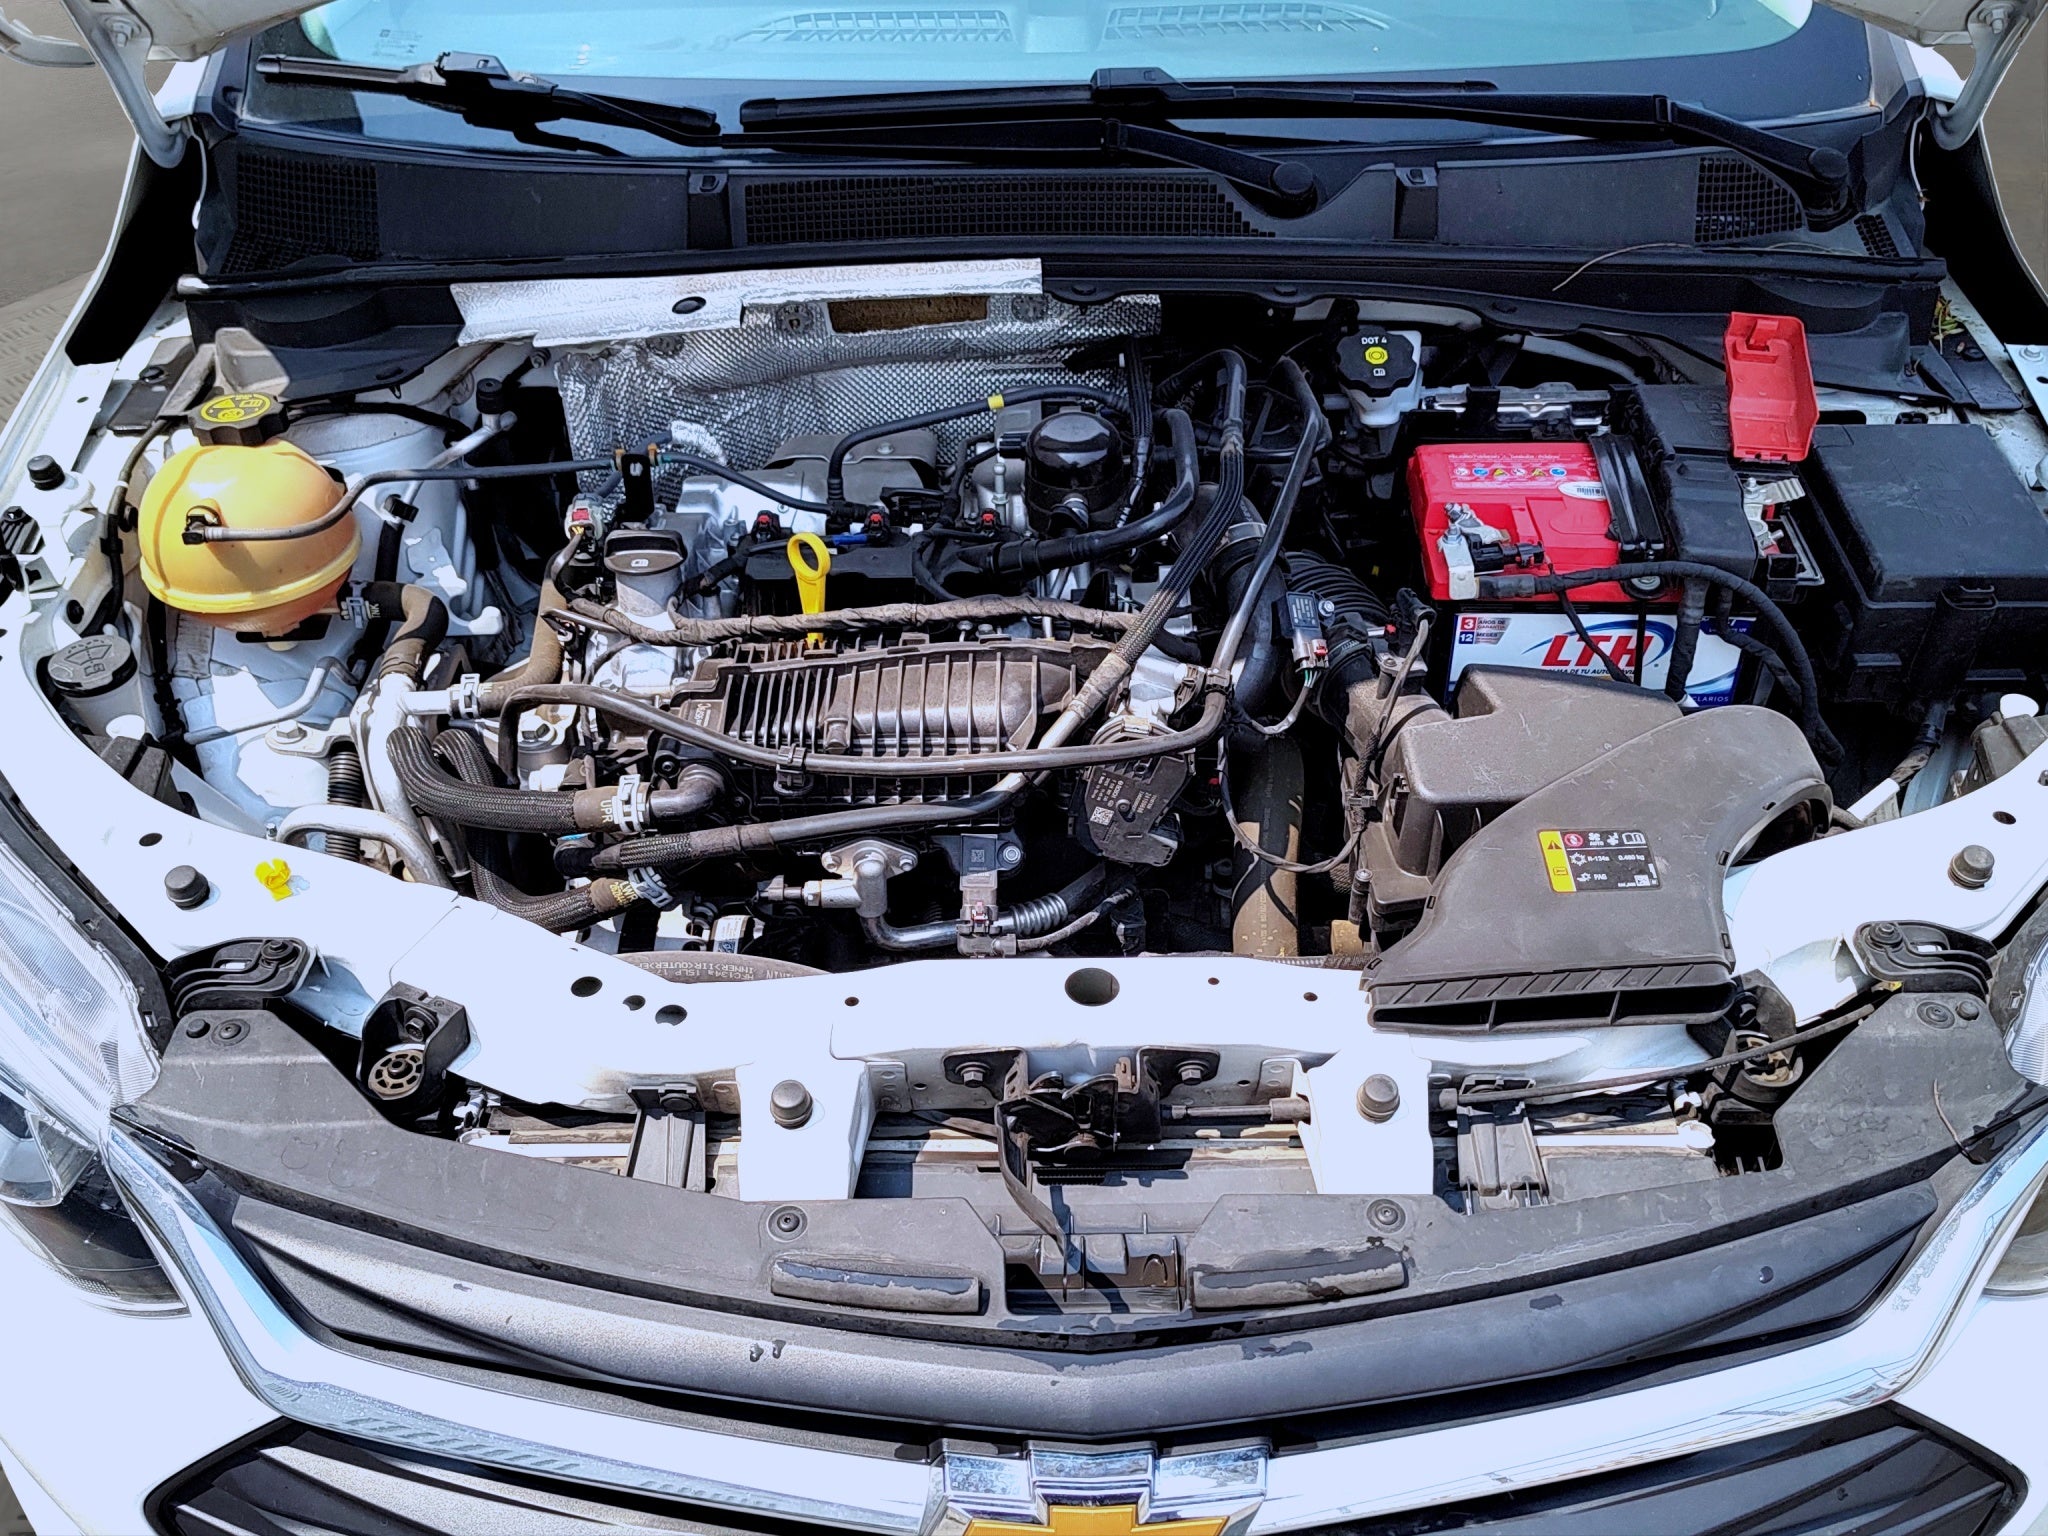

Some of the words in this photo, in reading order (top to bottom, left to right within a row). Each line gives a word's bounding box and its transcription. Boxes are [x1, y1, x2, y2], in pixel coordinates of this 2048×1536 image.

[1361, 336, 1379, 345] DOT
[1381, 336, 1387, 344] 4
[1463, 618, 1474, 629] 3
[1459, 633, 1474, 642] 12
[1541, 635, 1654, 667] LTH
[600, 799, 613, 823] UPR
[619, 881, 638, 901] LWR
